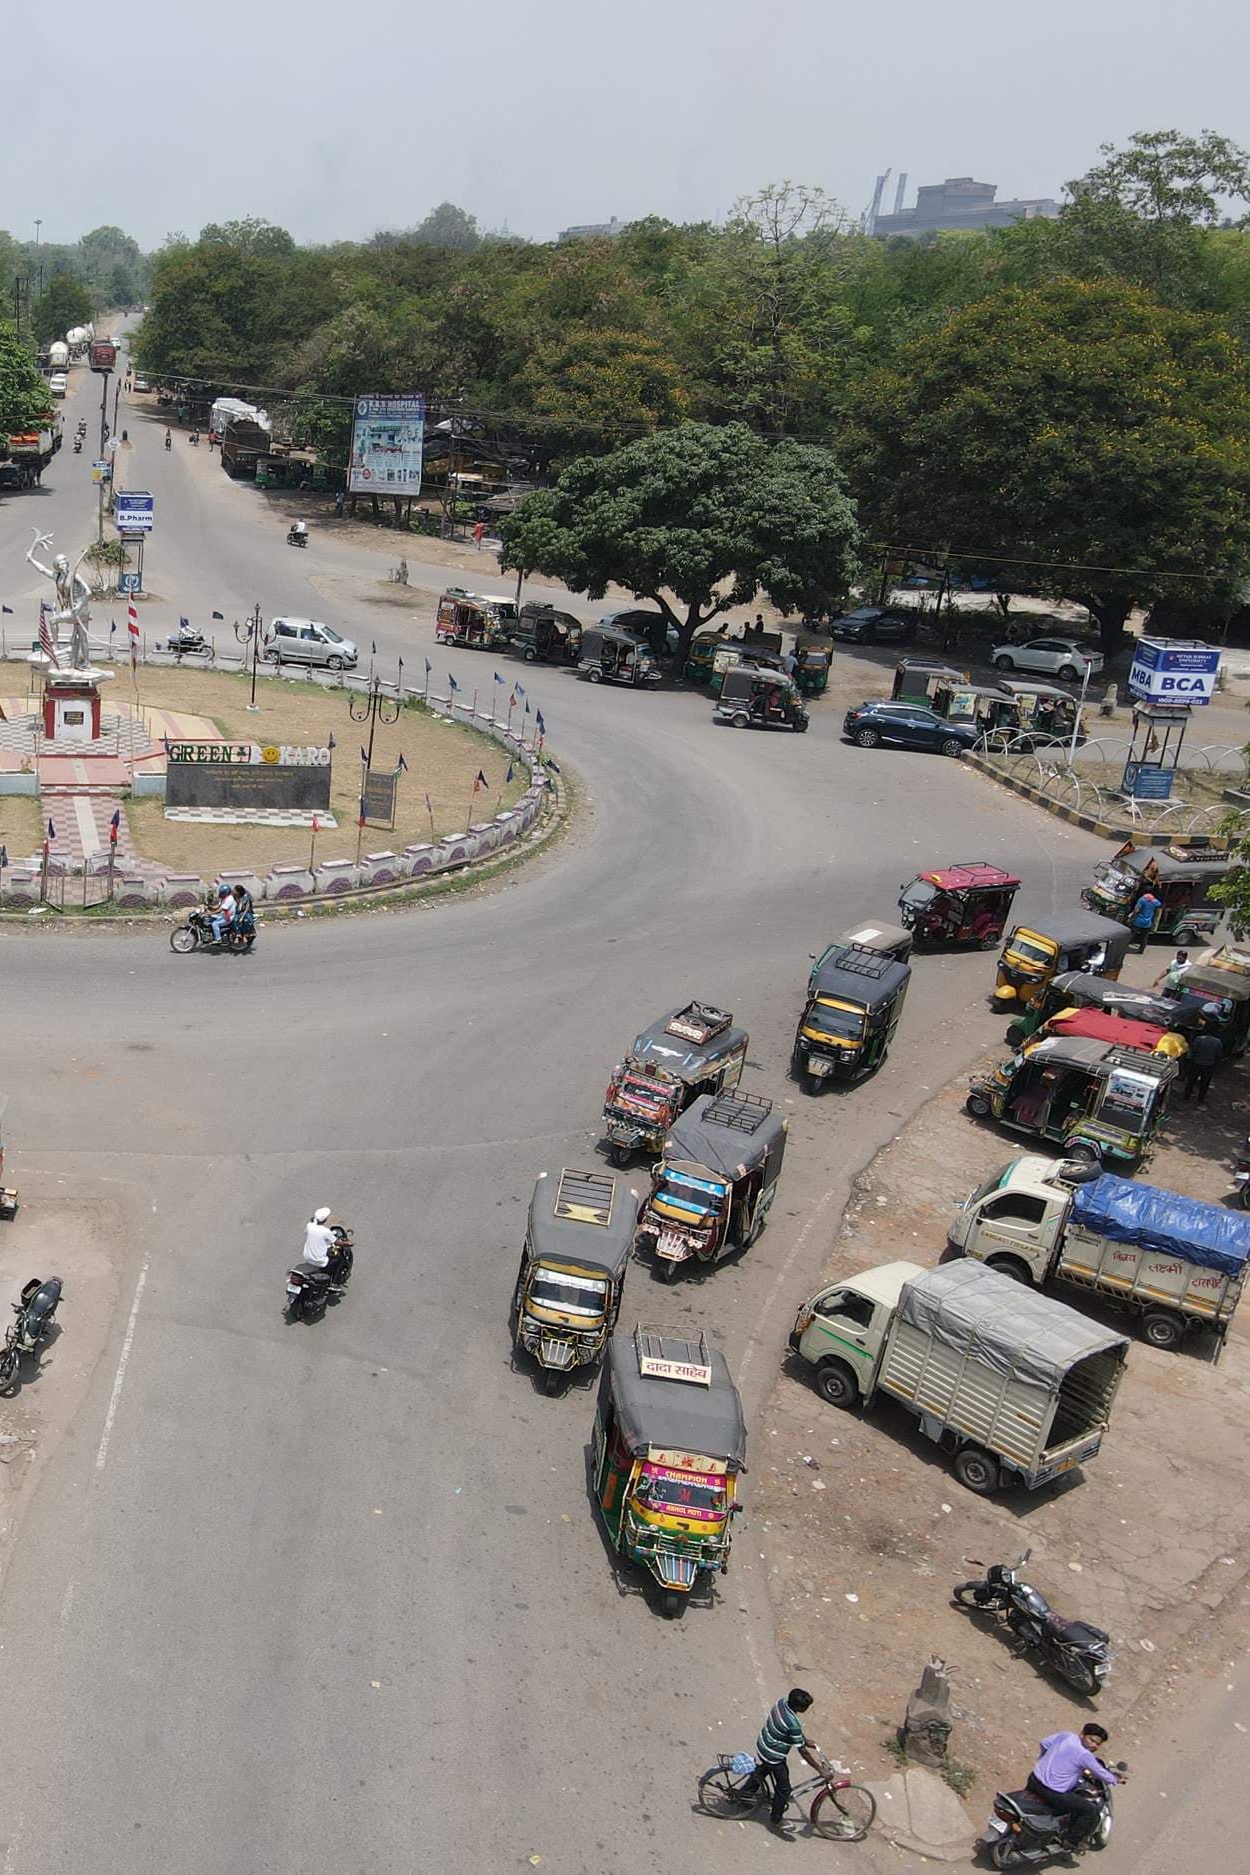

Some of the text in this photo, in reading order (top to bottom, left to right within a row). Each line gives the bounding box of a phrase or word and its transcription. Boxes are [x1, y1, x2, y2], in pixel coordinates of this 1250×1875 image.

[1131, 667, 1151, 689] MBA
[1161, 677, 1206, 692] BCA
[169, 745, 233, 763] GREEN
[646, 1361, 708, 1379] दादा साहेब
[665, 1471, 708, 1484] CHAMPION
